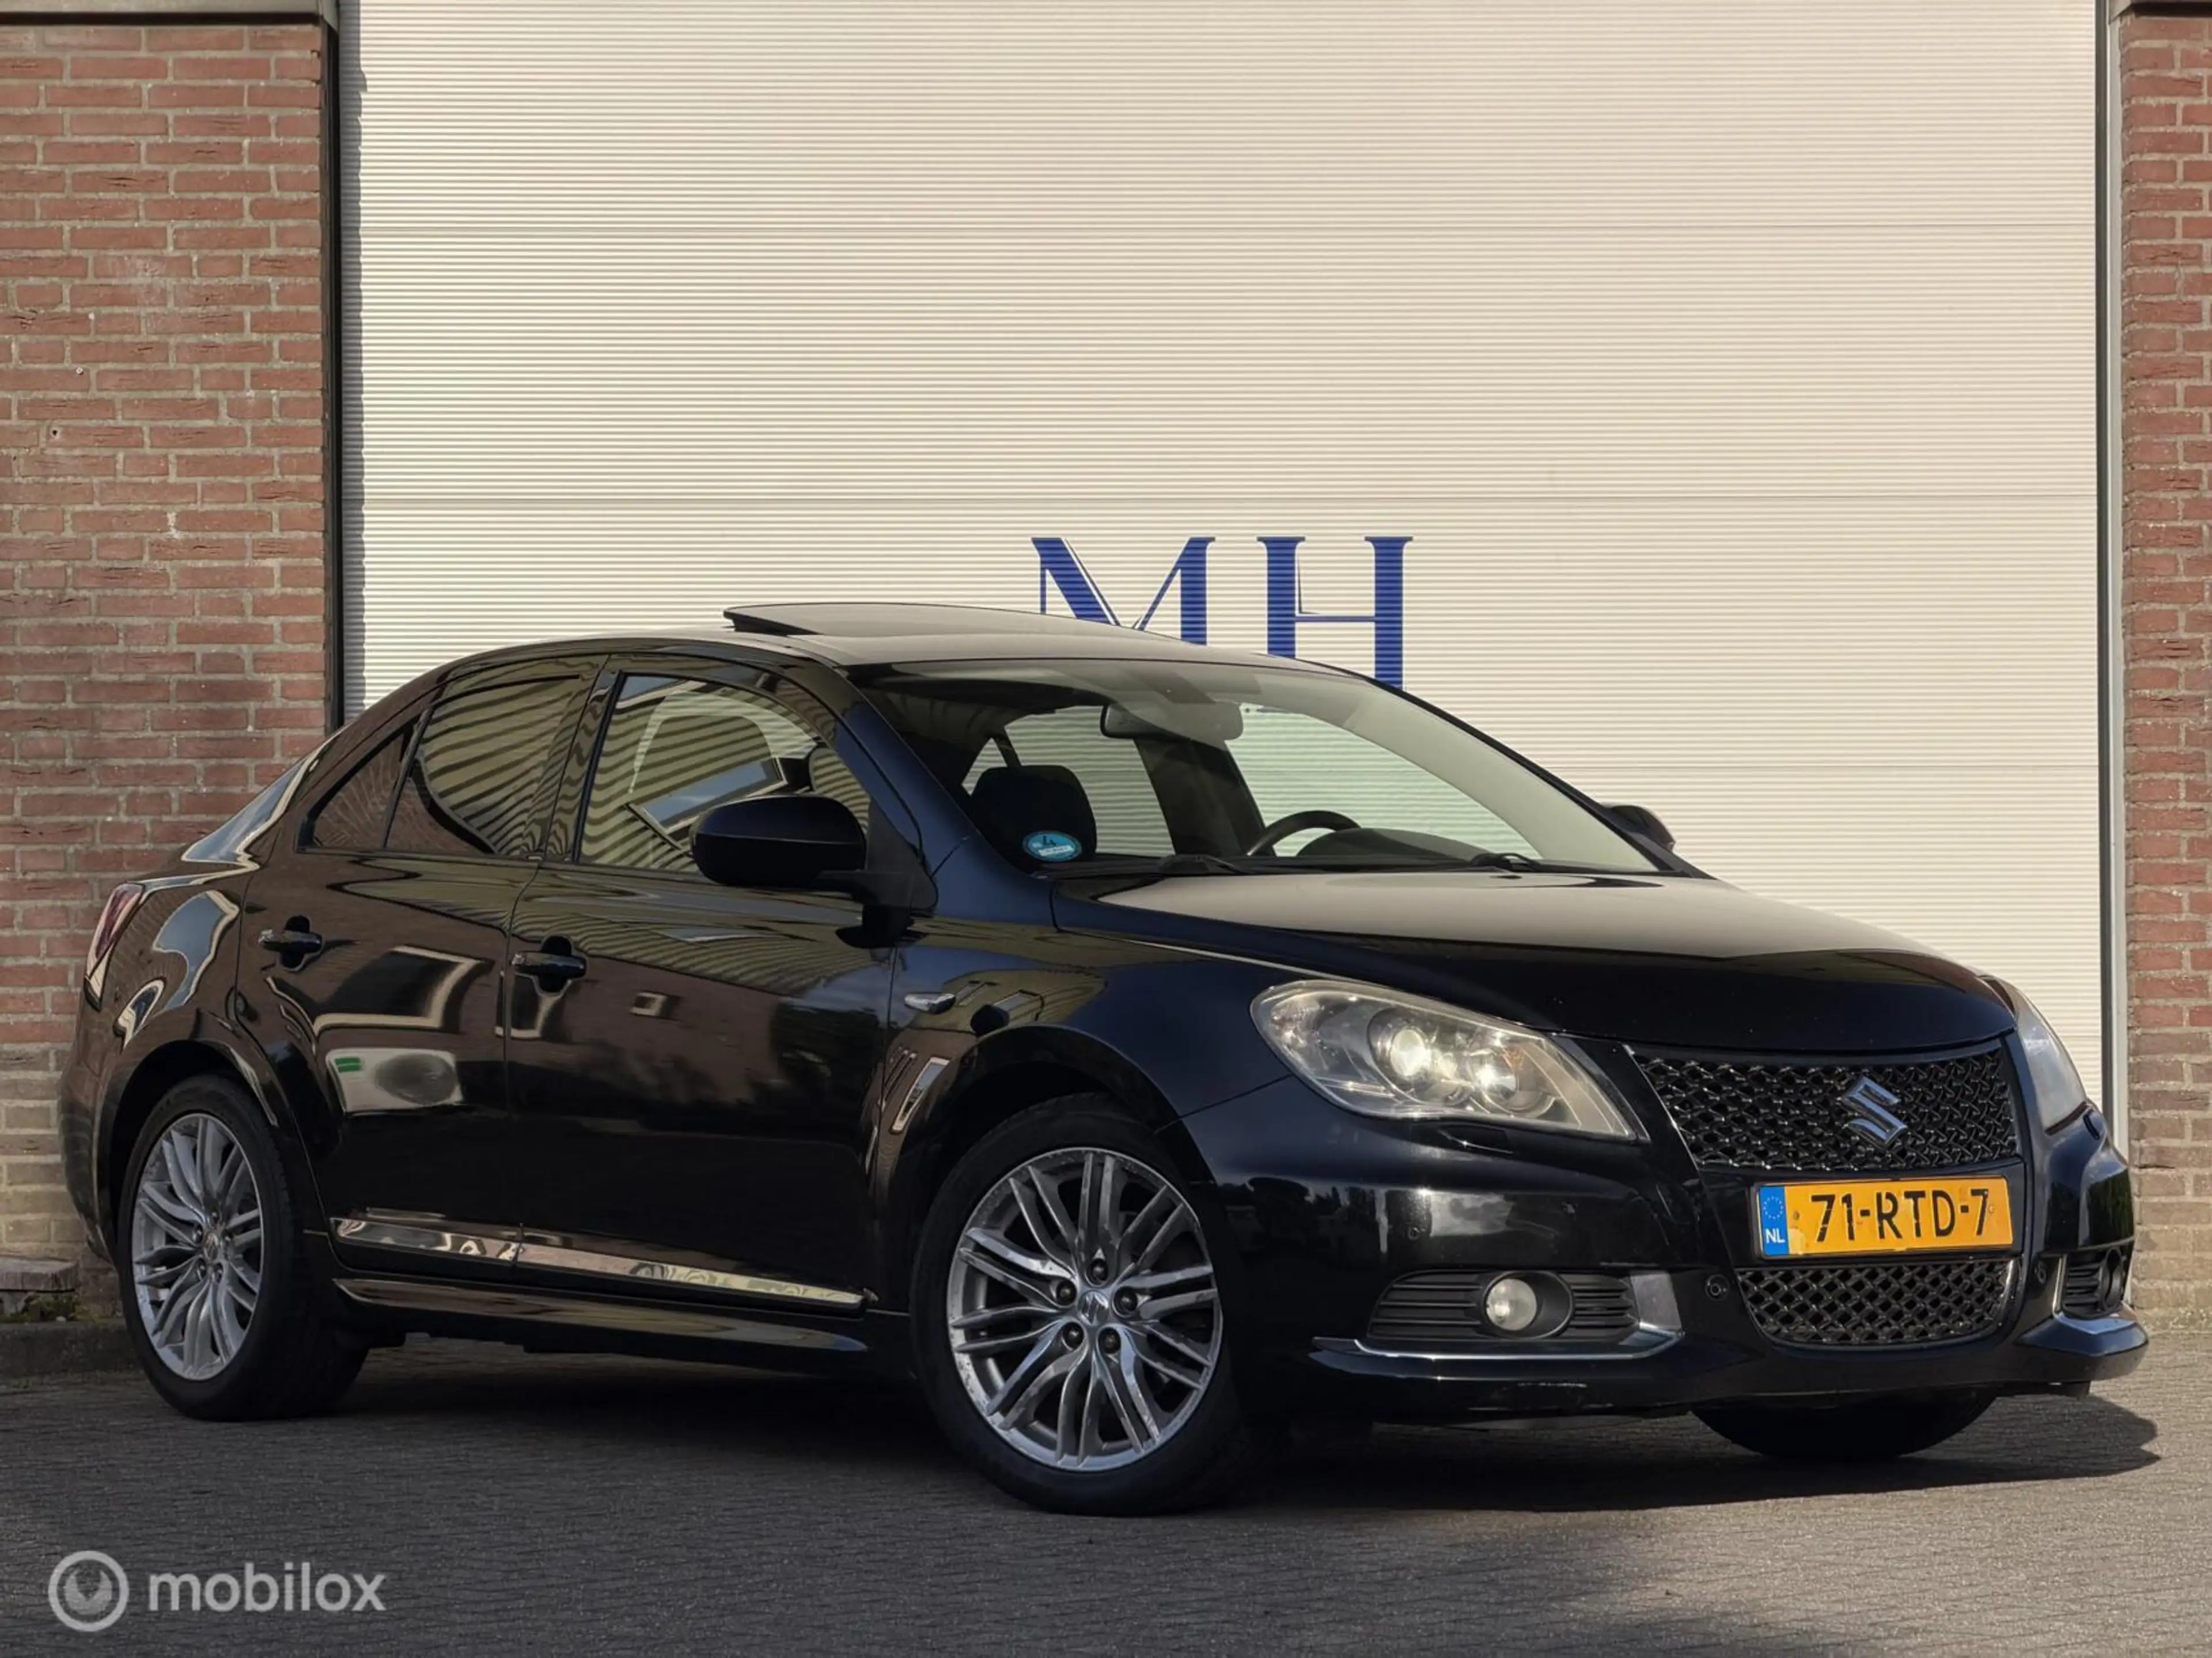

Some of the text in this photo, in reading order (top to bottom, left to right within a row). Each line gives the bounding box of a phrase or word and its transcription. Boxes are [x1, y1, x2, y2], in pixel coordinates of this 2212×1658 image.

[1031, 536, 1413, 690] MH
[1765, 1227, 1785, 1243] NL
[1811, 1187, 1989, 1242] 71-RTD-7
